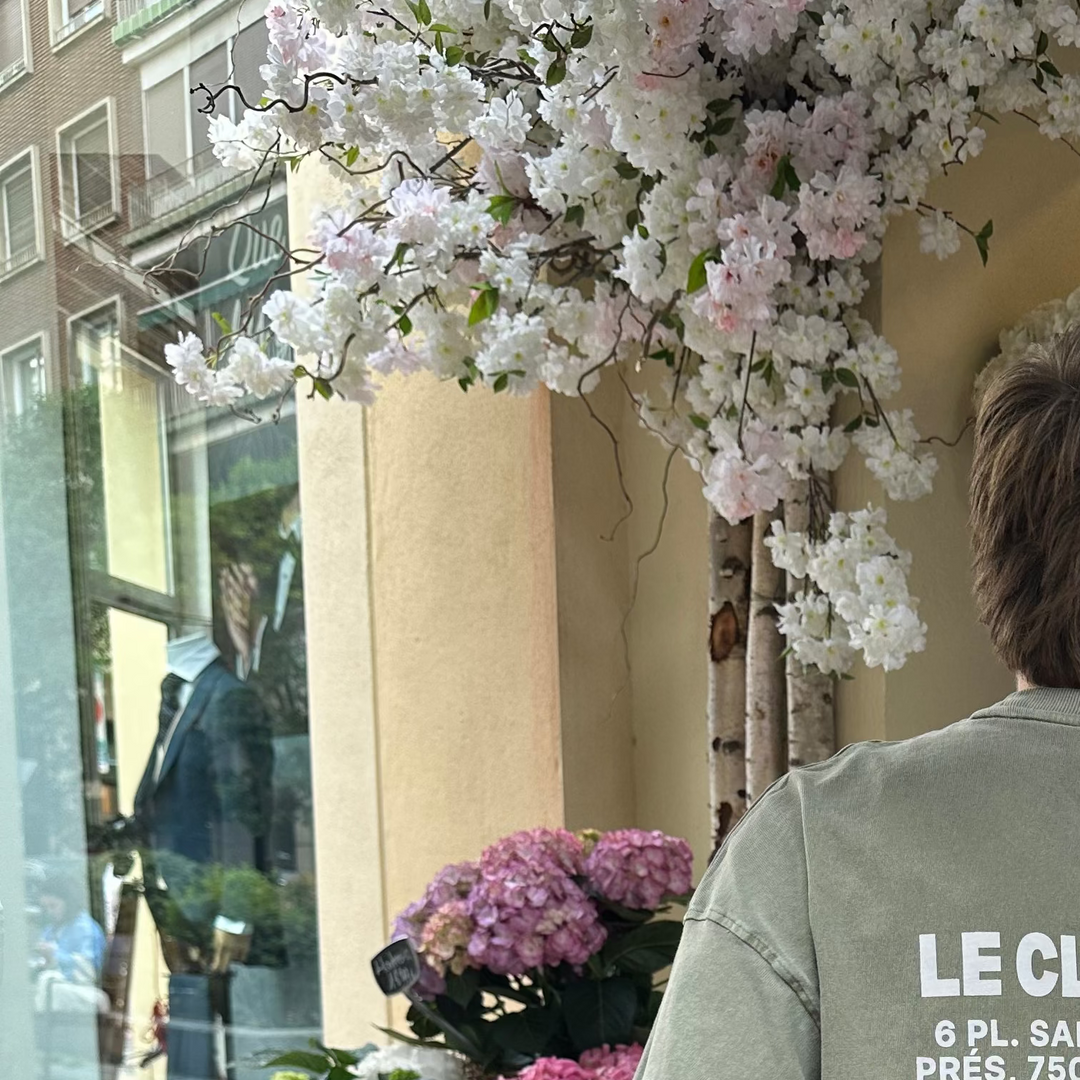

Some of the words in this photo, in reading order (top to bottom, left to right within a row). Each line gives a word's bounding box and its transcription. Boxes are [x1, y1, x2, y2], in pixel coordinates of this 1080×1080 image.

[919, 931, 1002, 998] LE
[935, 1019, 957, 1048] 6
[967, 1018, 1019, 1048] PL.
